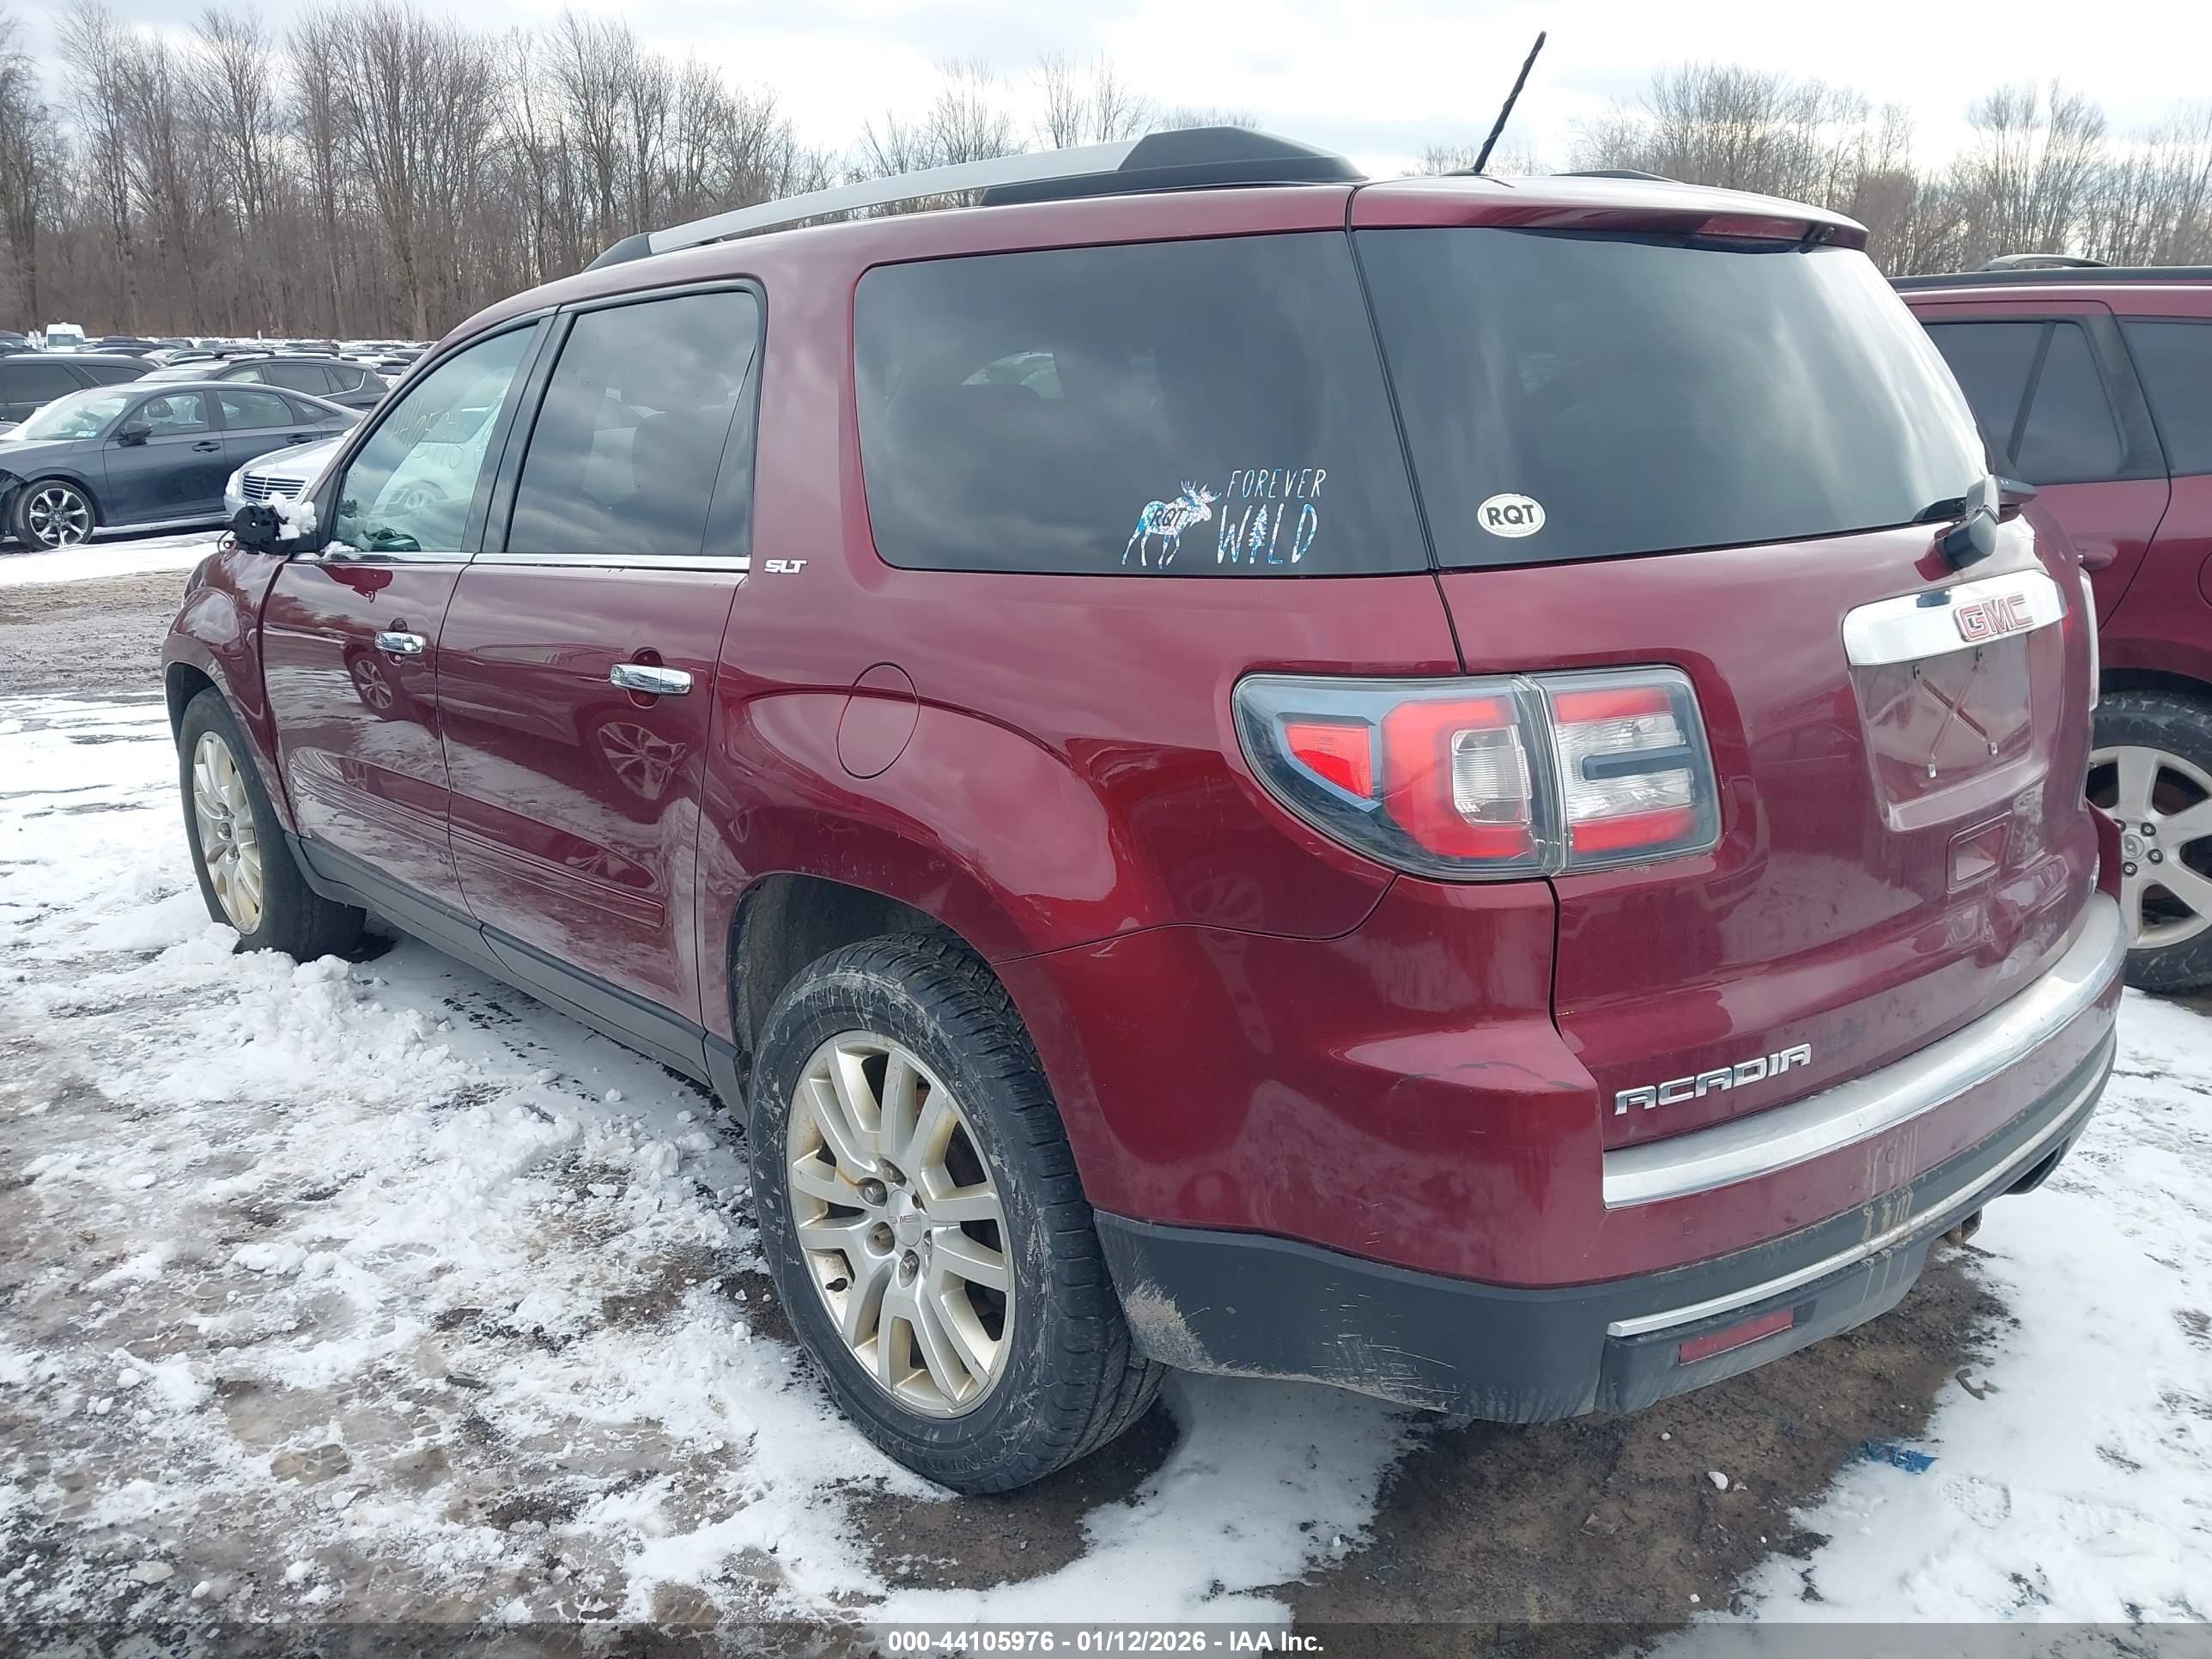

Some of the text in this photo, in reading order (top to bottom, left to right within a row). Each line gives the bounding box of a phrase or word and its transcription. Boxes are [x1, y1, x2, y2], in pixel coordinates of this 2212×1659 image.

[1227, 468, 1327, 498] FOREVER
[1149, 507, 1188, 527] RQT
[1486, 504, 1534, 526] RQT
[1218, 502, 1317, 564] WILD
[763, 559, 808, 574] SLT
[1954, 592, 2035, 641] GMC
[1614, 1042, 1812, 1116] ACADIA
